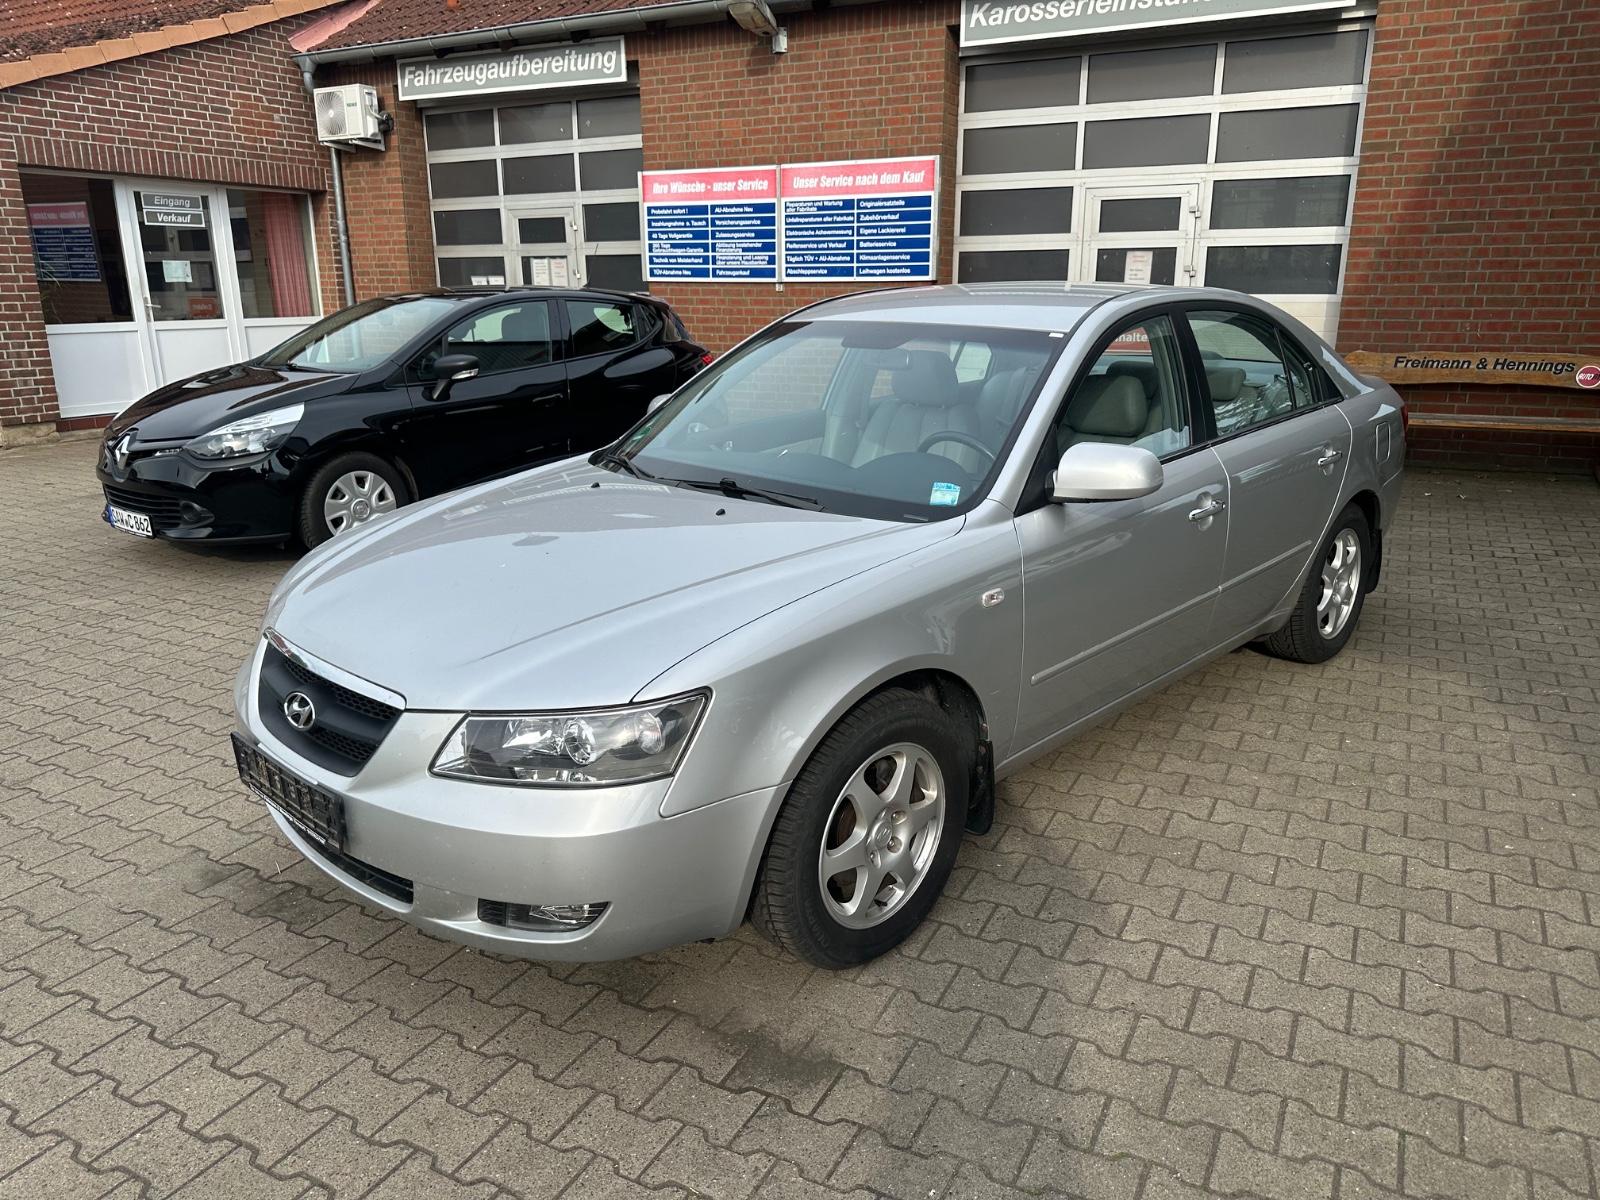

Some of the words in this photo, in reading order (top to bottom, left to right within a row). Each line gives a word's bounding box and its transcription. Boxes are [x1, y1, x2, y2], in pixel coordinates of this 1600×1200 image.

[969, 0, 1210, 28] Karosseriein
[404, 50, 617, 87] Fahrzeugaufbereitung
[653, 183, 668, 193] Ihre
[670, 181, 705, 193] Wünsche
[712, 182, 736, 192] unser
[737, 179, 769, 190] Service
[793, 177, 818, 188] Unser
[819, 175, 853, 187] Service
[855, 174, 877, 185] nach
[880, 173, 900, 184] dem
[902, 170, 925, 183] Kauf
[154, 196, 191, 207] Eingang
[157, 213, 191, 223] Verkauf
[1393, 356, 1471, 369] Freimann
[1476, 358, 1488, 370] &
[1492, 359, 1576, 374] Hennings
[127, 514, 134, 529] C
[134, 516, 151, 533] 862
